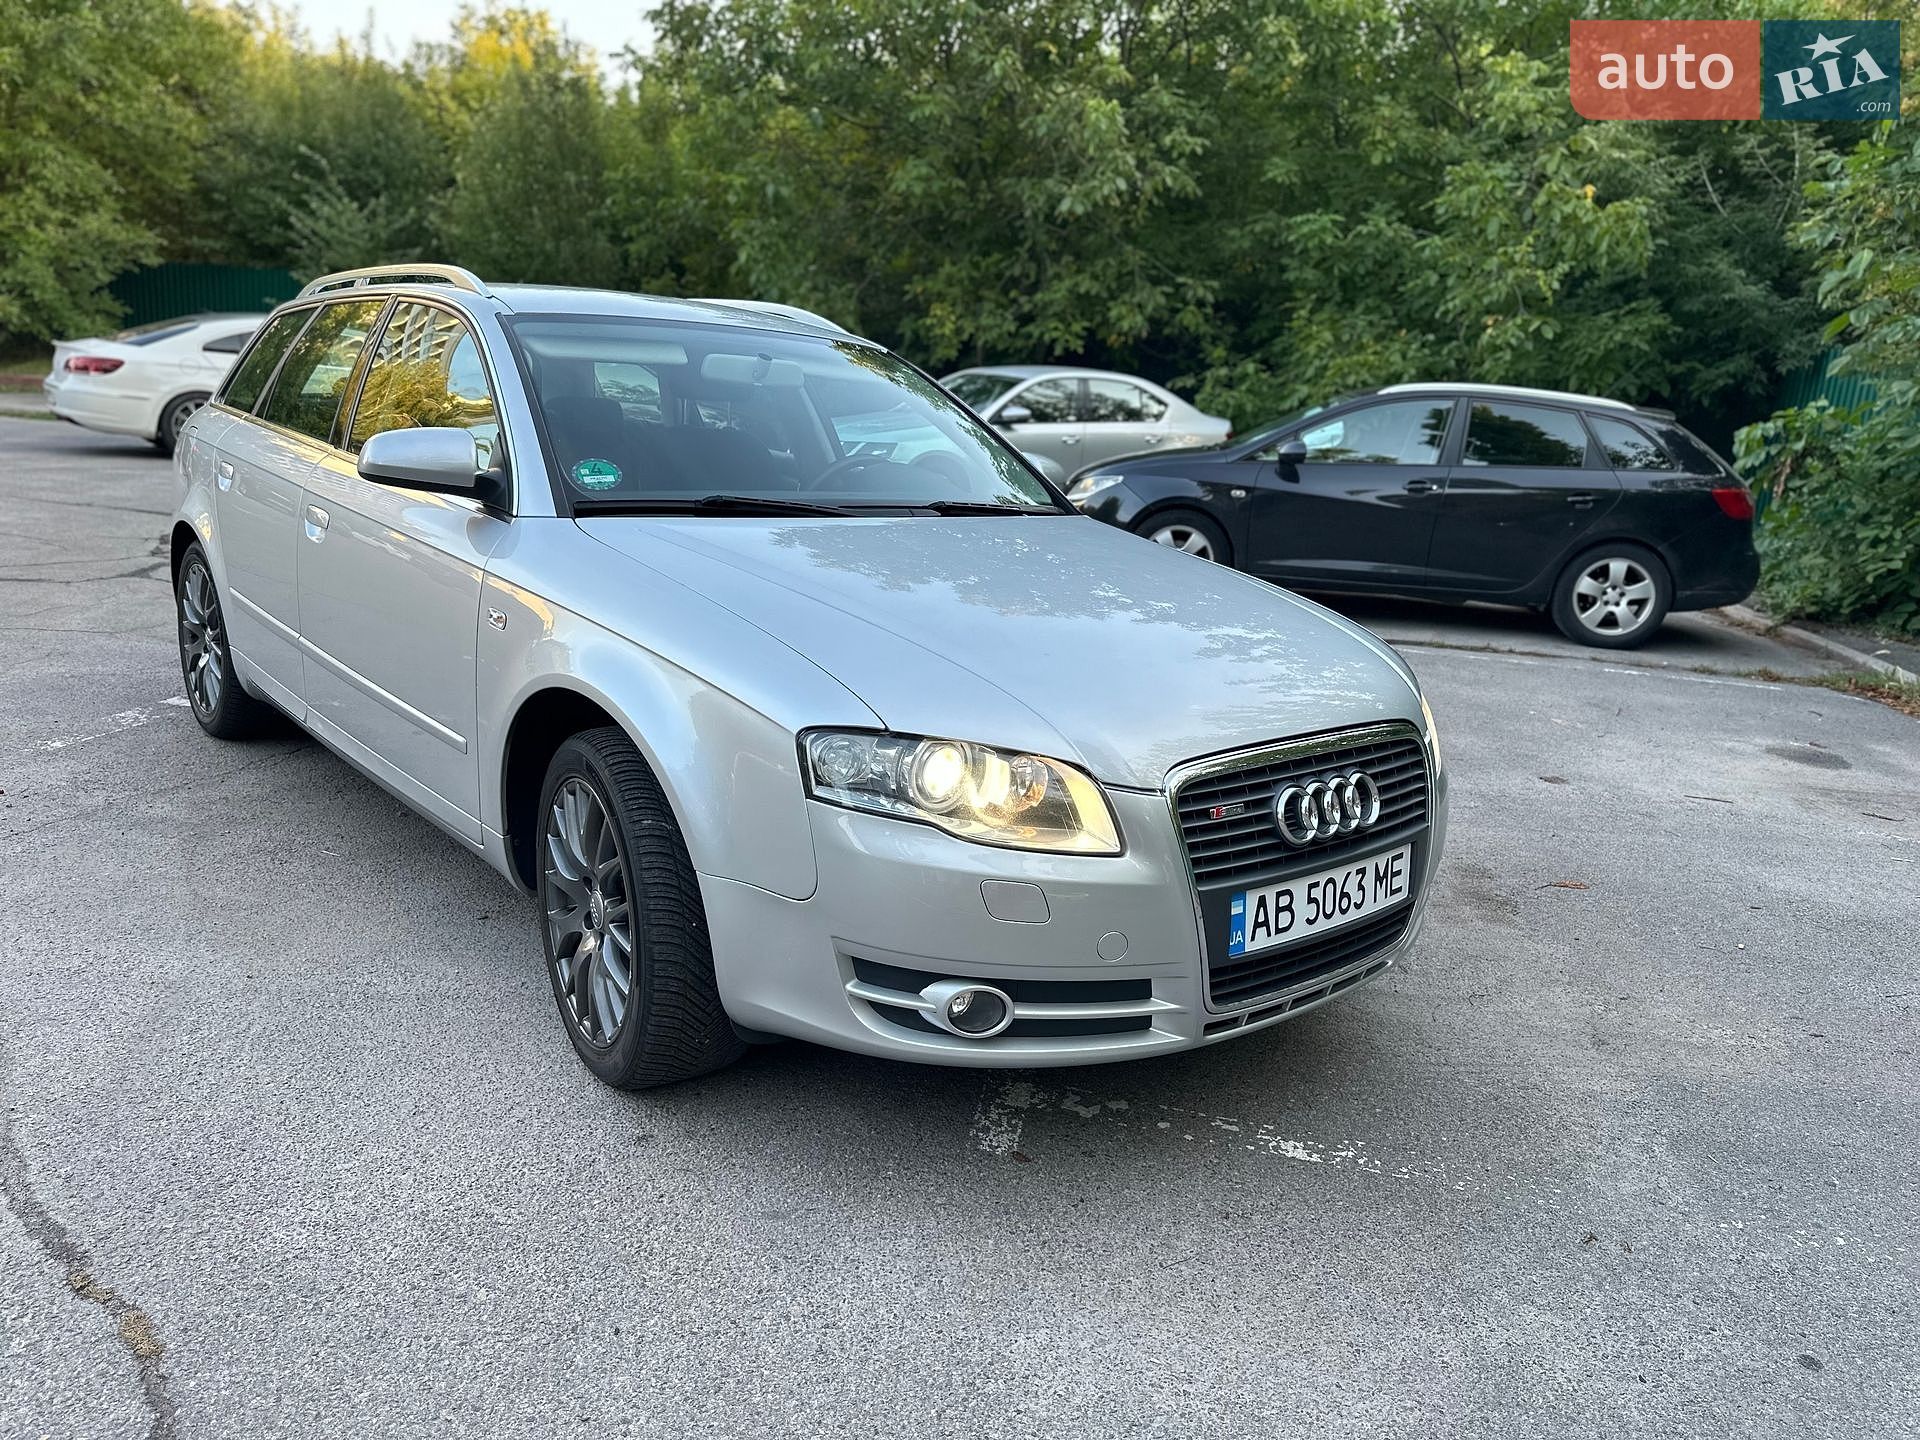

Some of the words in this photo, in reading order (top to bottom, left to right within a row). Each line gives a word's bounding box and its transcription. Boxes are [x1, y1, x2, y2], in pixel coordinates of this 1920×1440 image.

[1250, 888, 1296, 942] AB
[1305, 866, 1367, 926] 5063
[1373, 852, 1404, 903] ME
